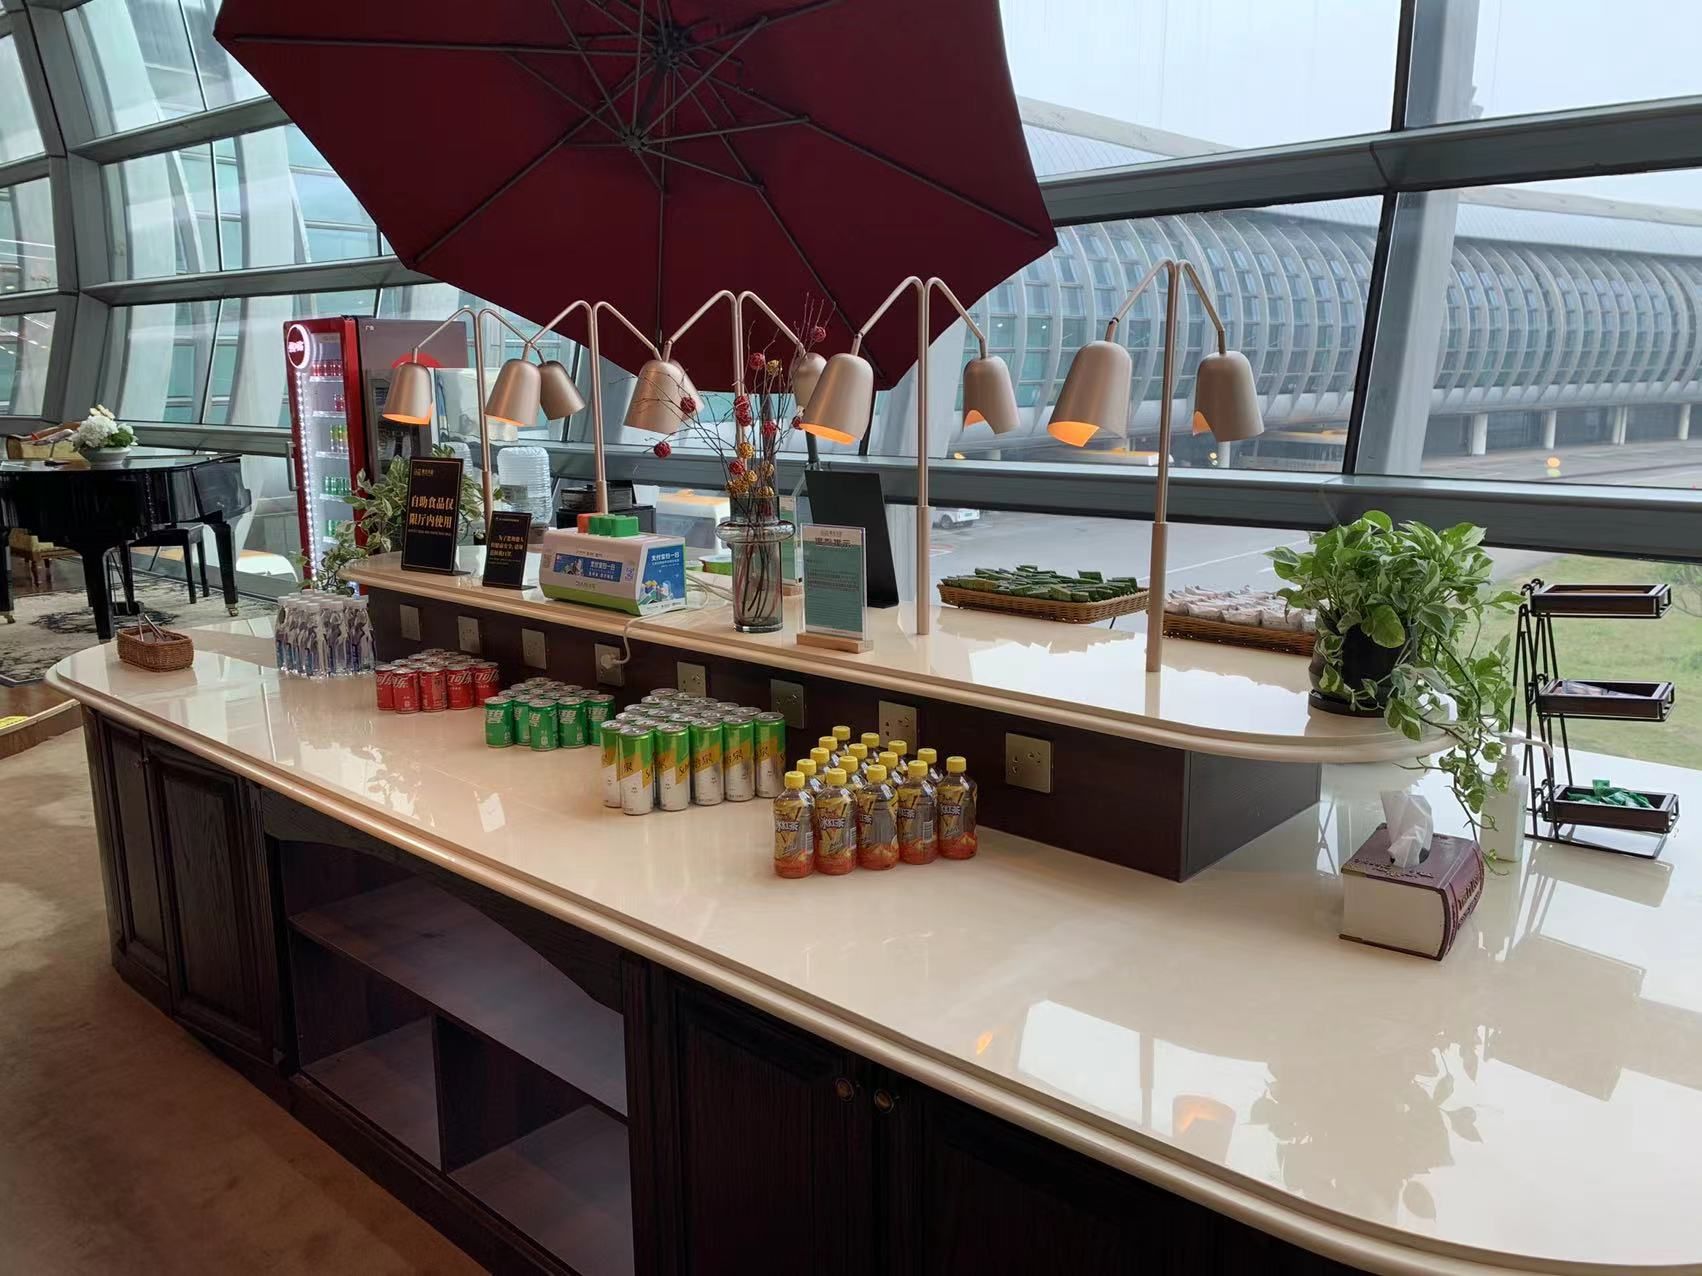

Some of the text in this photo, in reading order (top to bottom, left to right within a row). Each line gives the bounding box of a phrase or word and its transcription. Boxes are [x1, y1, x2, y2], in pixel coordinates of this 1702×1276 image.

[411, 495, 454, 510] 自助食品仅
[409, 513, 452, 528] 限厅内使用
